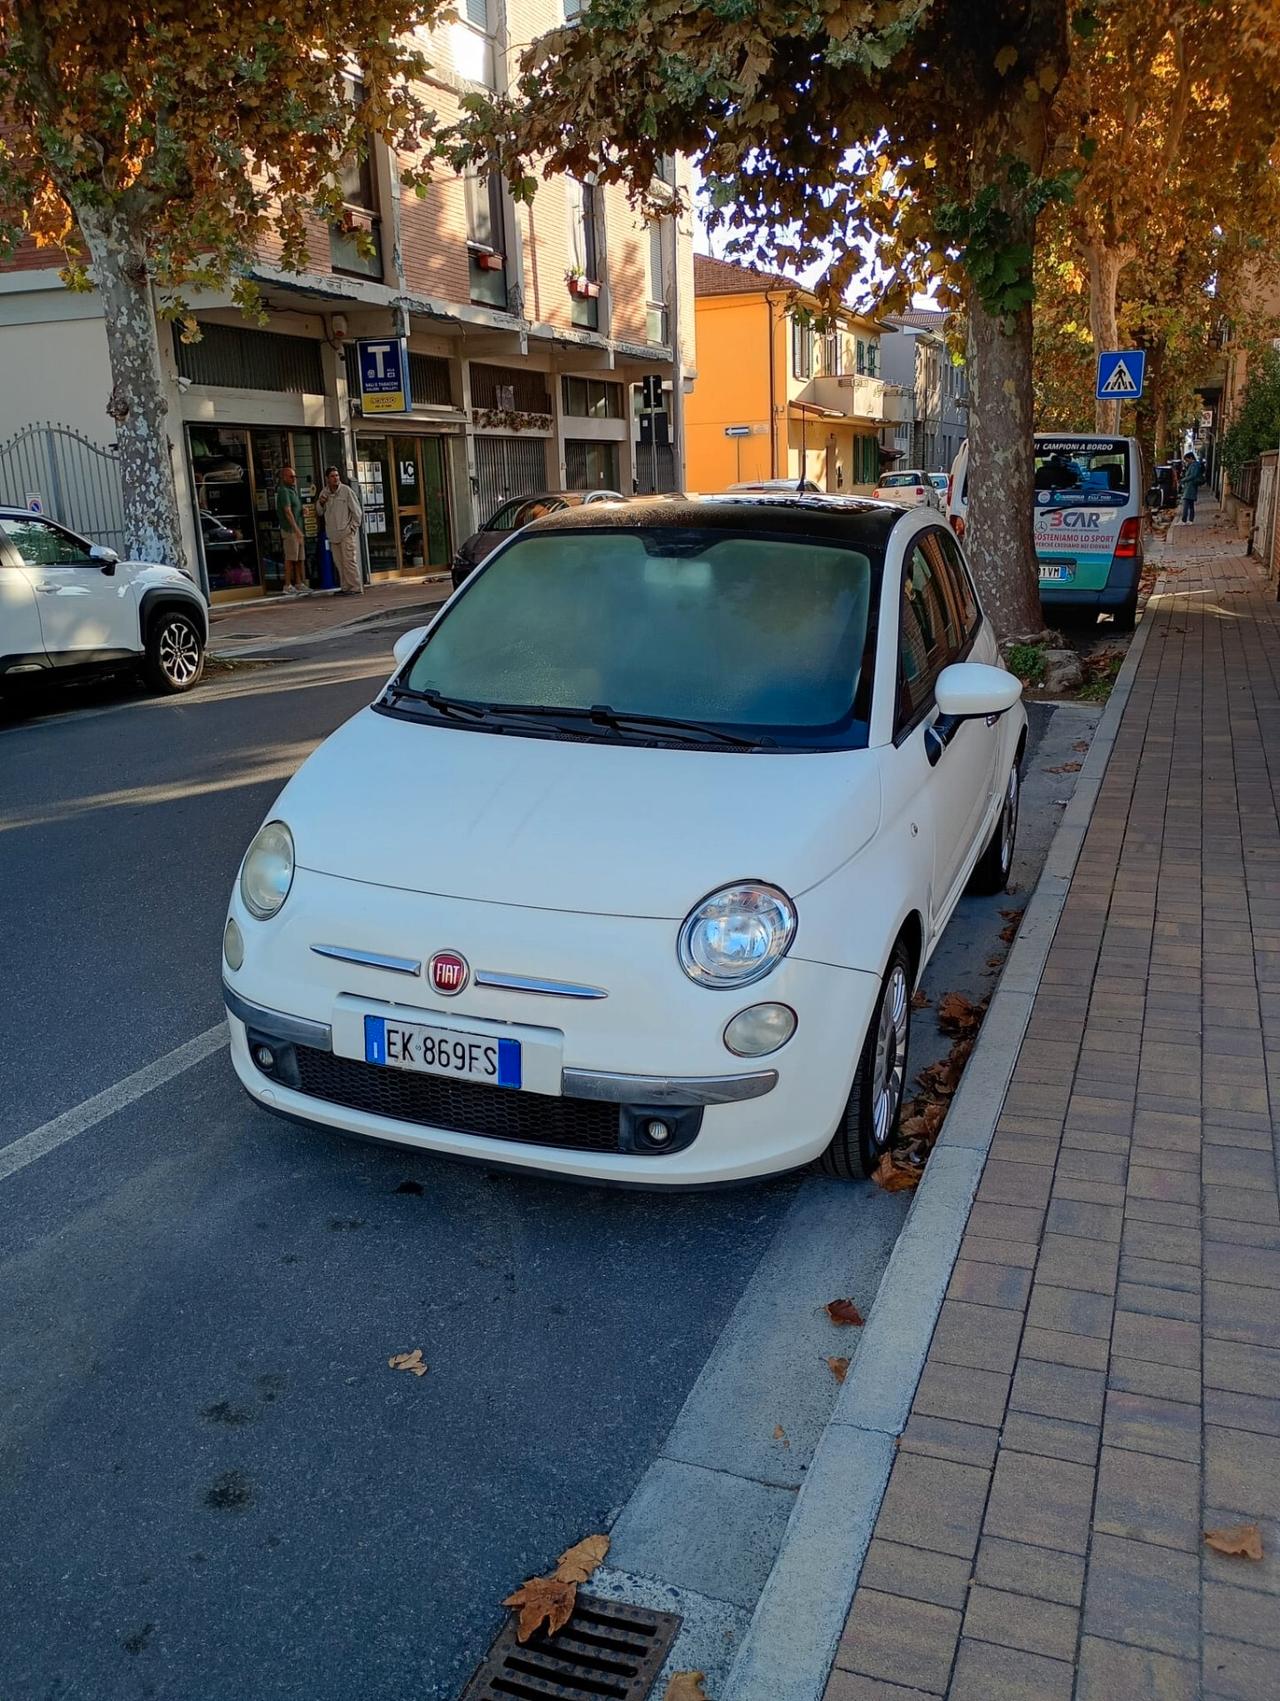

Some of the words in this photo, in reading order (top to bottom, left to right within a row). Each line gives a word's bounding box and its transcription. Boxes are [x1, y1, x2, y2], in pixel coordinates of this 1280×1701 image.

[367, 345, 391, 378] T
[1042, 443, 1079, 451] CAMPIONI
[1079, 443, 1086, 451] A
[1086, 443, 1113, 451] BORDO
[1050, 511, 1101, 528] 3CAR
[1080, 534, 1090, 543] LO
[1090, 535, 1114, 543] SPORT
[436, 962, 461, 985] FIAT
[387, 1029, 415, 1062] EK
[423, 1036, 497, 1076] 869FS
